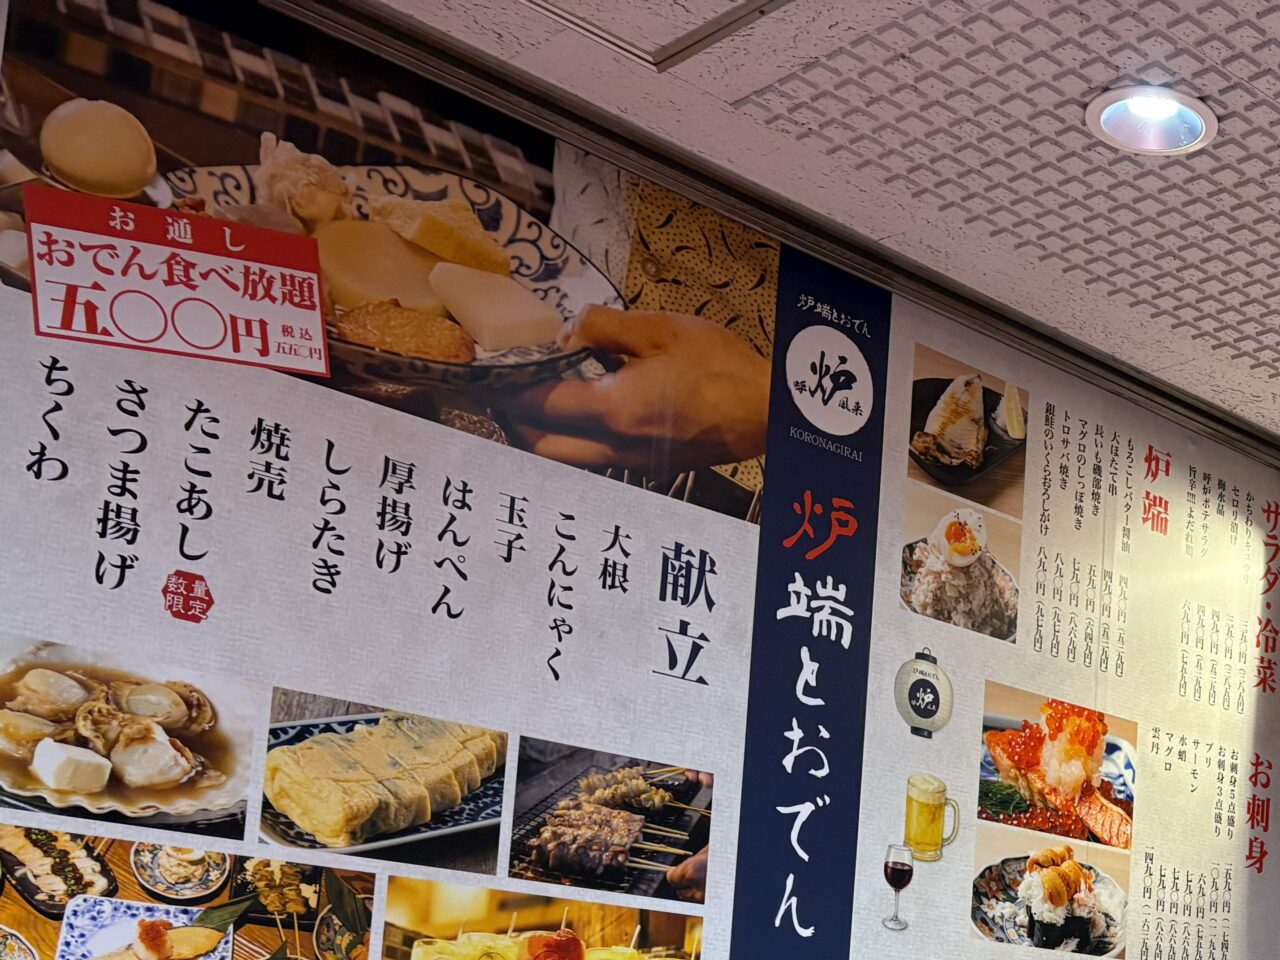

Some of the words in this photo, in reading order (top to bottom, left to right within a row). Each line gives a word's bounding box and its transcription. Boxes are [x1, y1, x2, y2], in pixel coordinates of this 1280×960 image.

[36, 230, 319, 312] おでん食べ放題
[109, 206, 247, 252] お通し
[281, 324, 313, 341] 税込
[26, 355, 77, 482] ちくわ
[246, 417, 292, 502] 焼売
[789, 426, 864, 462] KORONAGIRAI
[93, 379, 151, 590] さつま揚げ
[174, 398, 222, 561] たこあし
[310, 438, 354, 595] しらたき
[373, 455, 418, 576] 厚揚げ
[1141, 443, 1173, 536] 炉端
[430, 477, 474, 621] はんぺん
[492, 493, 530, 564] 玉子
[598, 525, 632, 594] 大根
[543, 511, 580, 683] こんにゃく
[651, 540, 719, 687] 献立
[1150, 726, 1161, 755] 雲丹
[1164, 731, 1175, 772] マグロ
[1190, 739, 1201, 793] サーモン
[1243, 751, 1274, 875] お刺身
